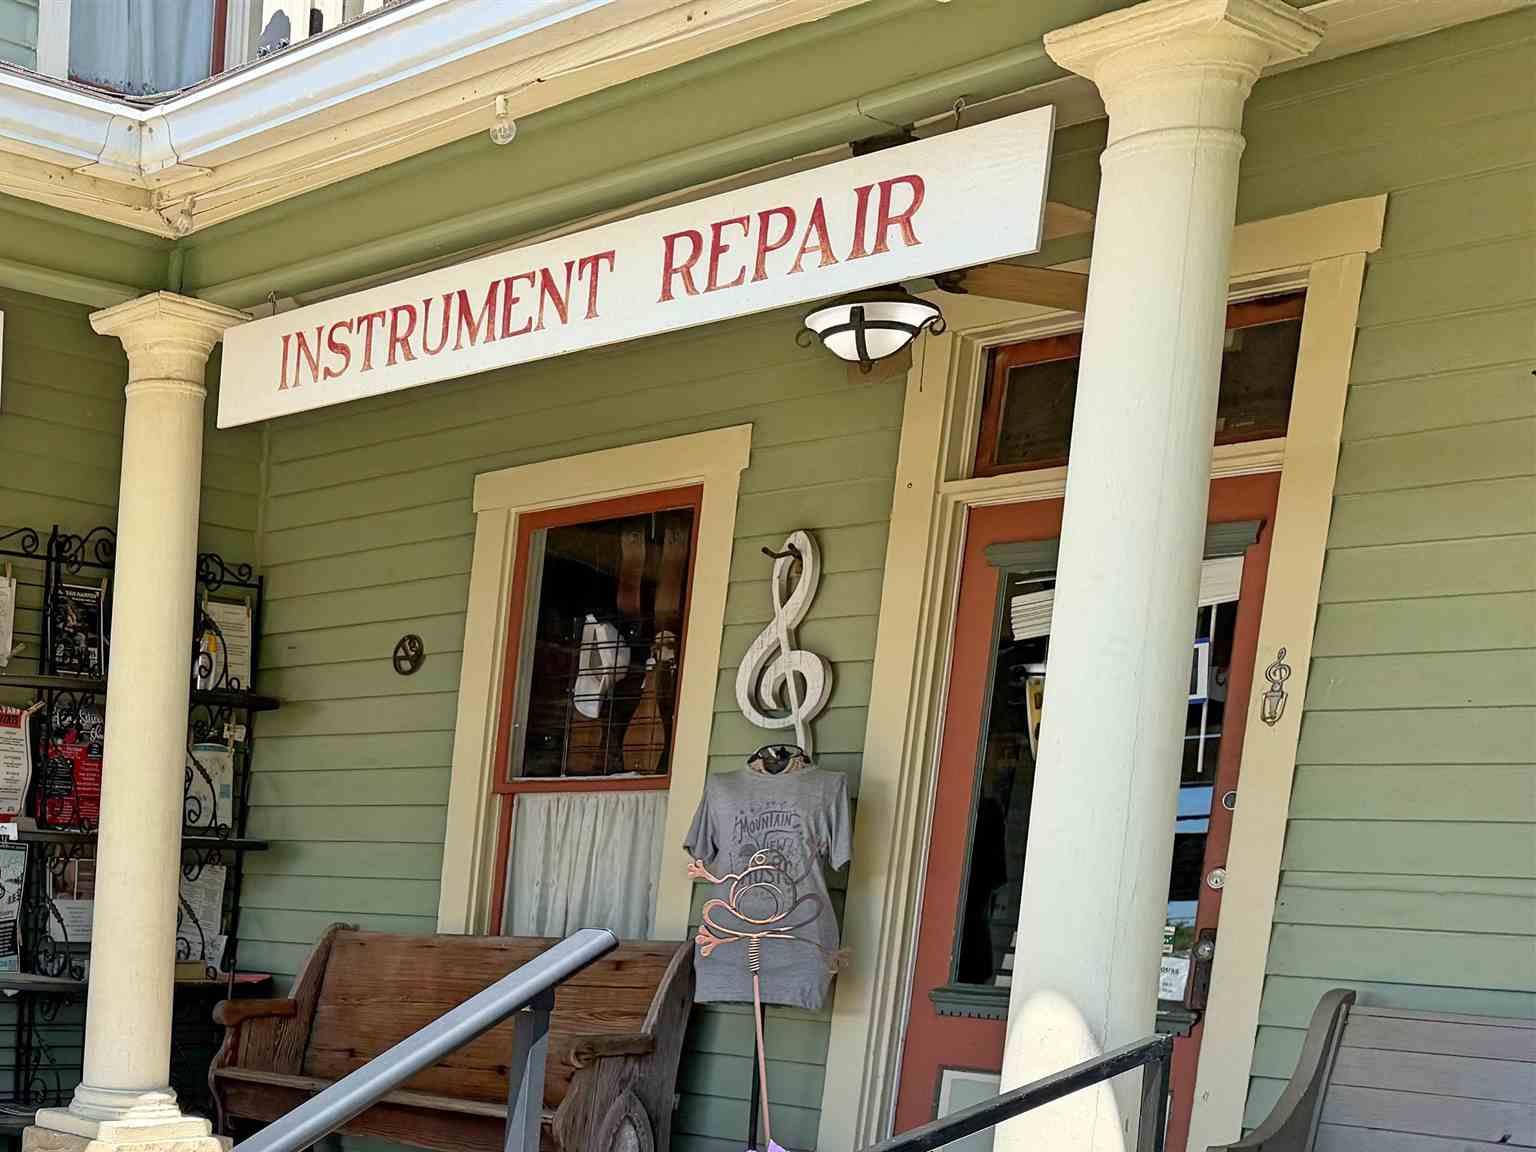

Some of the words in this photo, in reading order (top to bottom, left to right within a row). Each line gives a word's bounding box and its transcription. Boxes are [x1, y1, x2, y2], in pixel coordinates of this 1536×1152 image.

[278, 249, 616, 391] INSTRUMENT
[657, 173, 926, 304] REPAIR
[735, 811, 792, 843] MOUNTAIN
